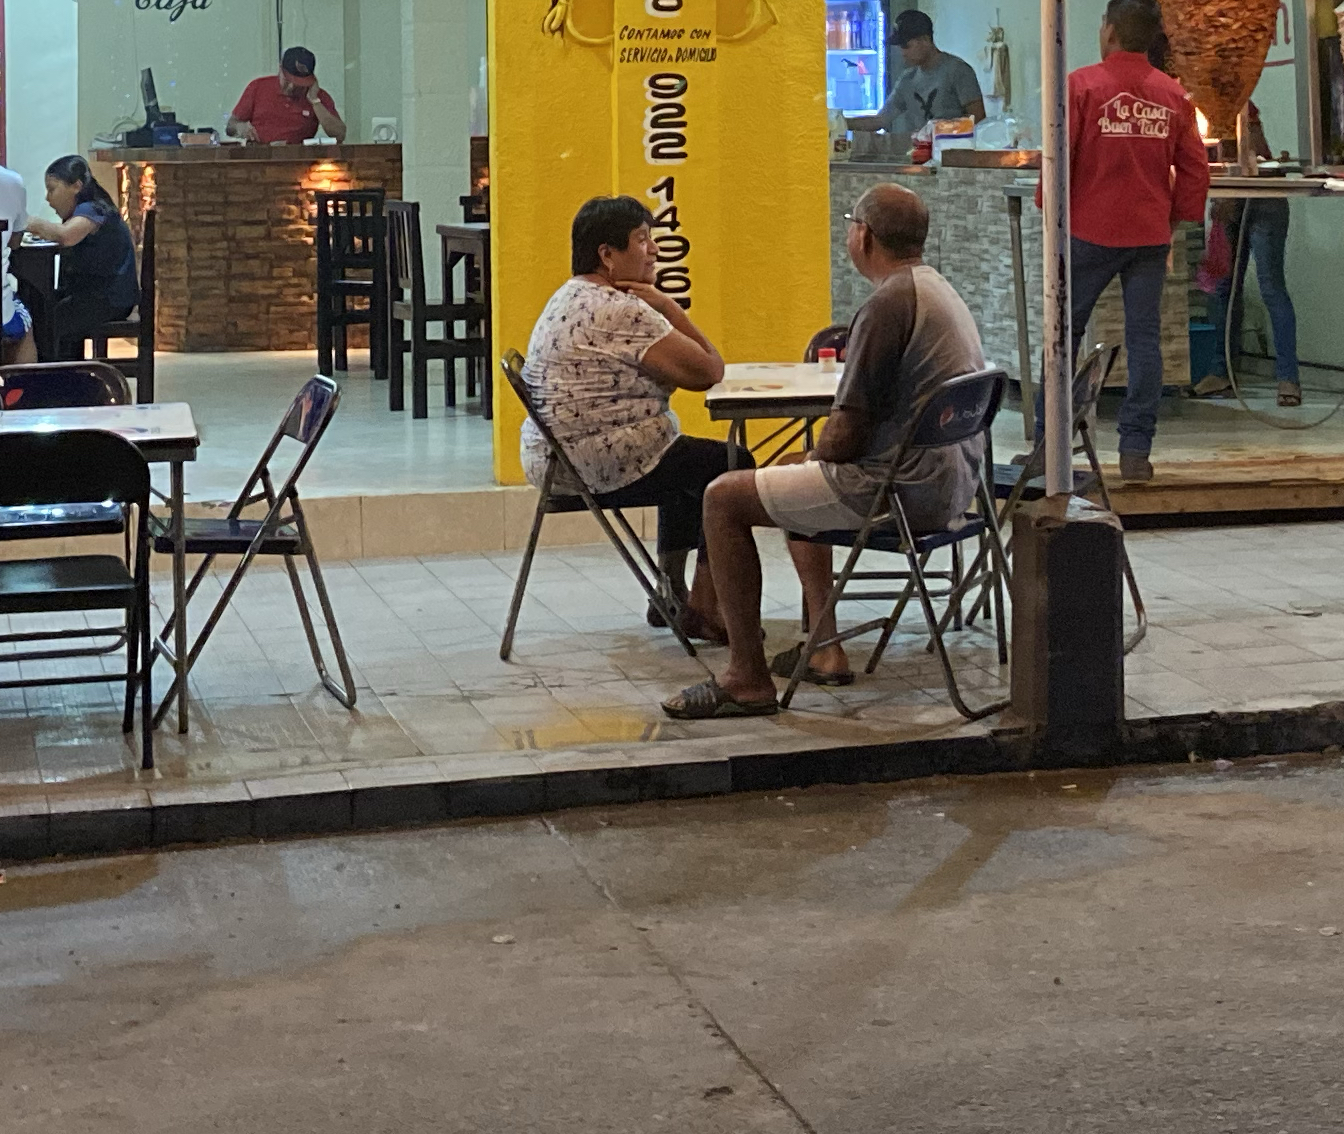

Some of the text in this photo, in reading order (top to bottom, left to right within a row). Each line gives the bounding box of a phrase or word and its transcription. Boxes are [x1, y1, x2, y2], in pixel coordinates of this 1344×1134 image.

[619, 24, 712, 41] CONTAMOS CON
[619, 46, 668, 64] SERVICIO
[675, 46, 717, 63] DOMICILIO
[645, 72, 689, 163] 922
[1112, 99, 1168, 120] La Casa
[1097, 116, 1133, 134] Buen
